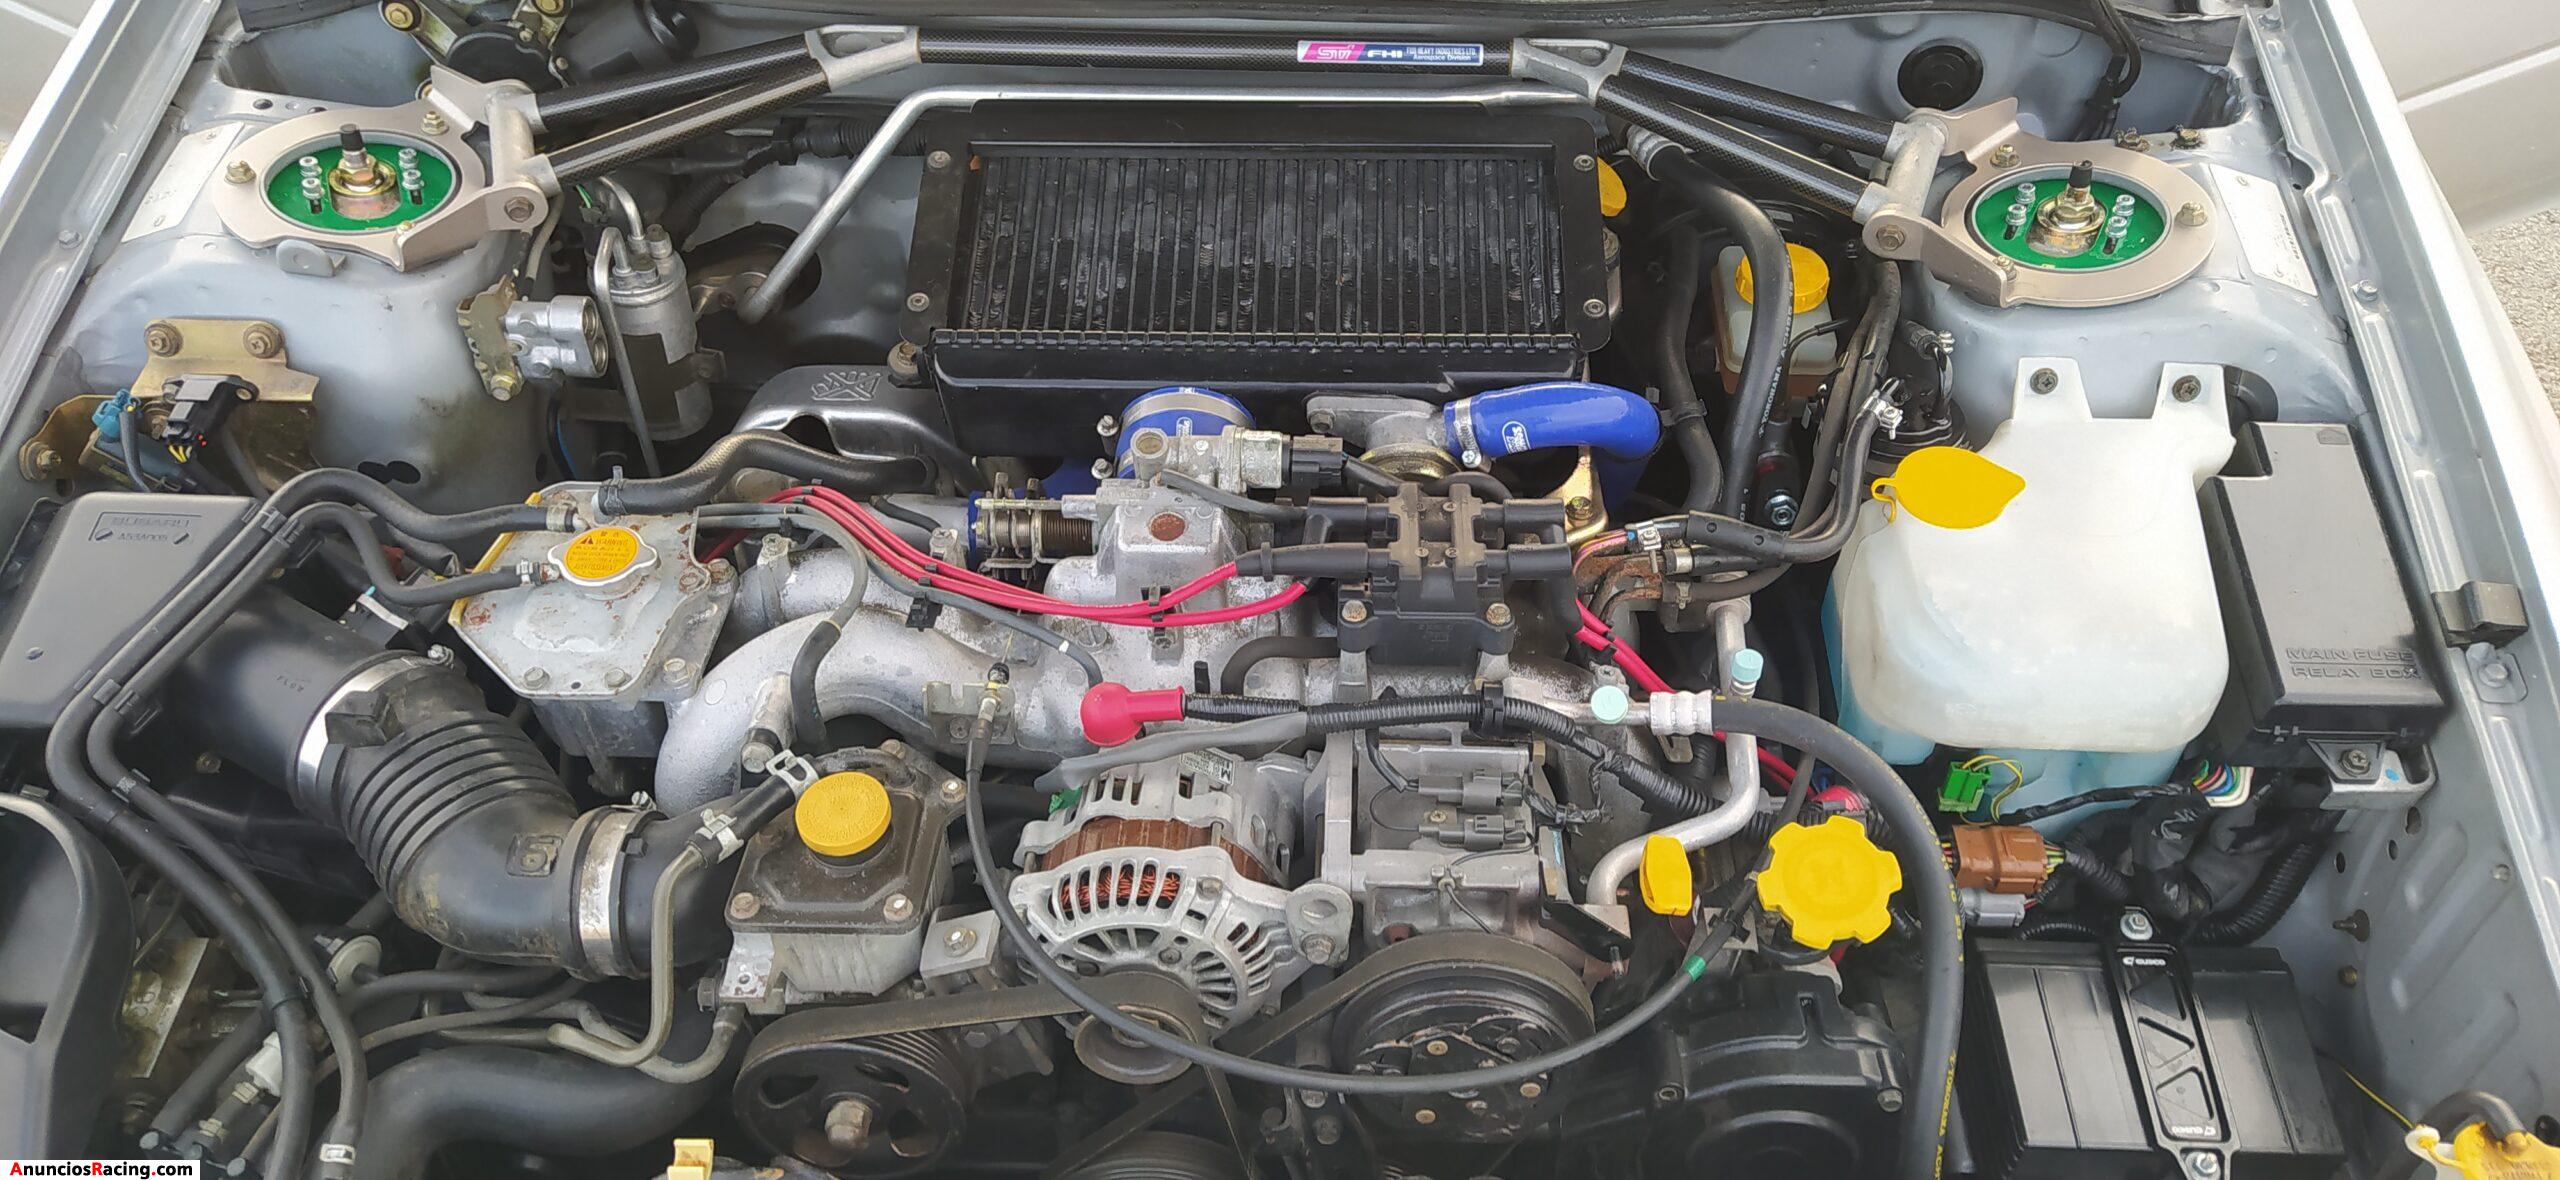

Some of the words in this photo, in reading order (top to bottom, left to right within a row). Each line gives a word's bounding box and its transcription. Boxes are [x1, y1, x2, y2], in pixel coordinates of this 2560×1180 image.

[1367, 49, 1403, 58] FHI
[1417, 47, 1434, 55] HEAVY
[1435, 47, 1465, 56] INDUSTRIES
[1413, 54, 1446, 62] Aerospace
[1762, 366, 1783, 425] YOKOHAMA
[2285, 648, 2347, 661] MAIN
[2353, 648, 2414, 662] FUSE
[2291, 665, 2361, 679] RELAY
[2368, 666, 2421, 680] BOX
